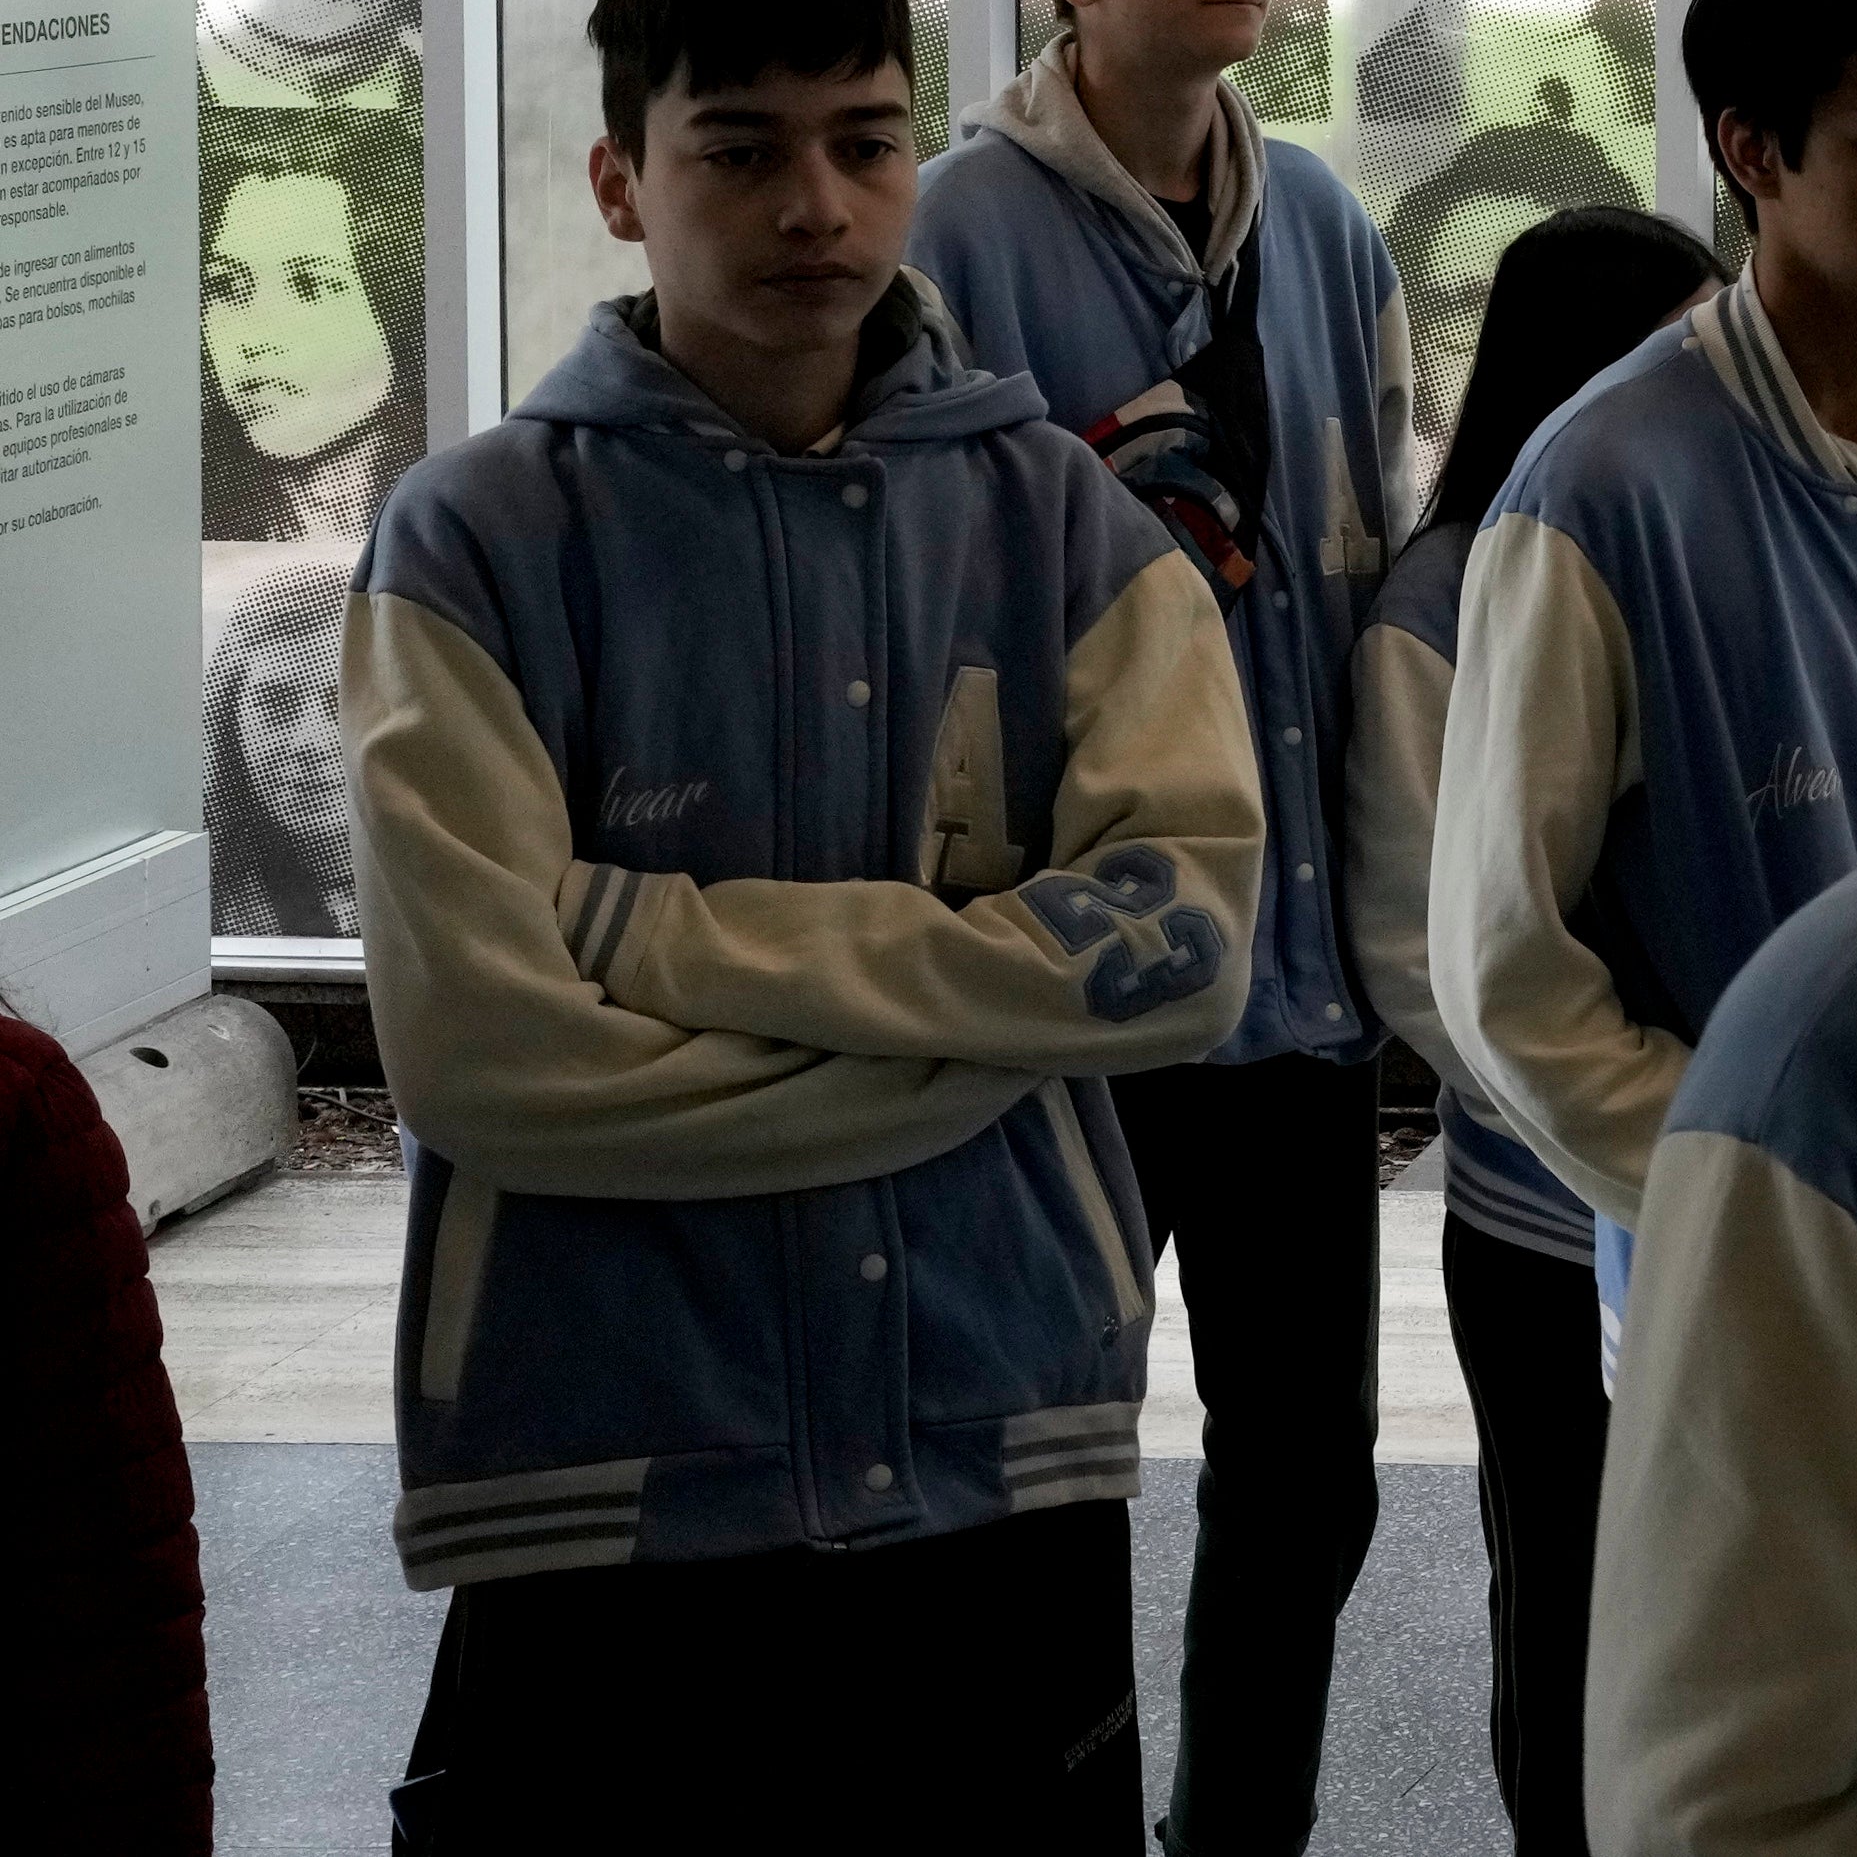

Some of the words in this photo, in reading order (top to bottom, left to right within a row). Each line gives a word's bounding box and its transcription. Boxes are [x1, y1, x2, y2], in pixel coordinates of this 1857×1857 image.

[2, 13, 110, 45] ENDACIONES
[36, 99, 81, 118] sensible
[85, 95, 102, 111] del
[5, 137, 17, 148] es
[21, 129, 46, 149] apta
[50, 127, 74, 145] para
[78, 121, 124, 139] menores
[128, 116, 140, 130] de
[11, 150, 73, 174] excepción.
[76, 147, 105, 163] Entre
[109, 142, 121, 158] 12
[123, 146, 130, 159] y
[134, 138, 146, 154] 15
[11, 182, 38, 199] estar
[42, 170, 119, 195] acompañados
[123, 166, 141, 184] por
[14, 254, 58, 277] ingresar
[62, 251, 81, 267] con
[84, 241, 135, 262] alimentos
[6, 287, 19, 303] Se
[23, 276, 77, 298] encuentra
[80, 262, 134, 288] disponible
[137, 261, 146, 277] el
[19, 308, 43, 329] para
[47, 300, 86, 320] bolsos,
[88, 290, 135, 311] mochilas
[27, 383, 36, 399] el
[40, 381, 59, 396] uso
[63, 375, 77, 391] de
[80, 367, 125, 388] cámaras
[16, 411, 41, 428] Para
[45, 404, 54, 421] la
[58, 392, 111, 418] utilización
[114, 389, 128, 406] de
[3, 436, 47, 458] equipos
[50, 416, 122, 447] profesionales
[125, 413, 137, 427] se
[22, 448, 91, 477] autorización.
[11, 517, 25, 531] su
[918, 665, 1026, 891] A
[1745, 742, 1840, 832] Alvea
[600, 766, 708, 829] lvear
